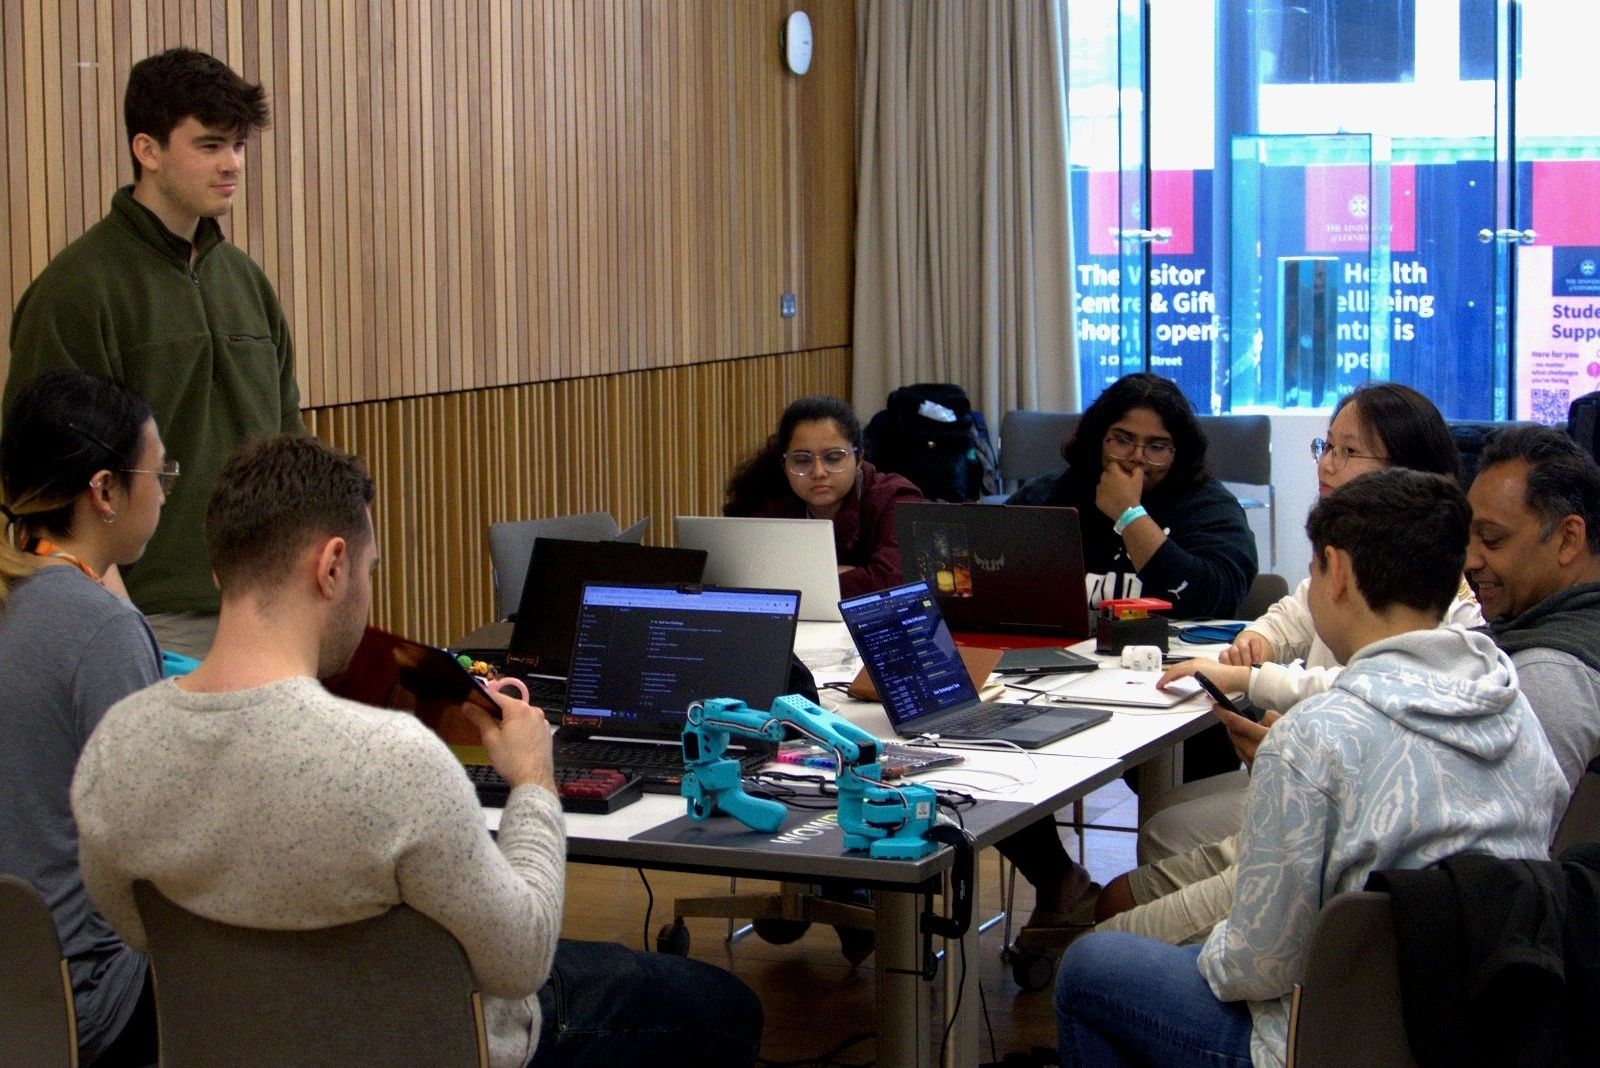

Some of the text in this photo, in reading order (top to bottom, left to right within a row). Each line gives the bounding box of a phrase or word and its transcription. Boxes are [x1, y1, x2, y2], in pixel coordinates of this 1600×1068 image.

[1077, 263, 1206, 286] The Vsitor
[1344, 261, 1427, 284] Helth
[1150, 291, 1168, 314] &
[1156, 324, 1217, 346] open
[1394, 317, 1415, 341] is
[1150, 355, 1183, 367] Street
